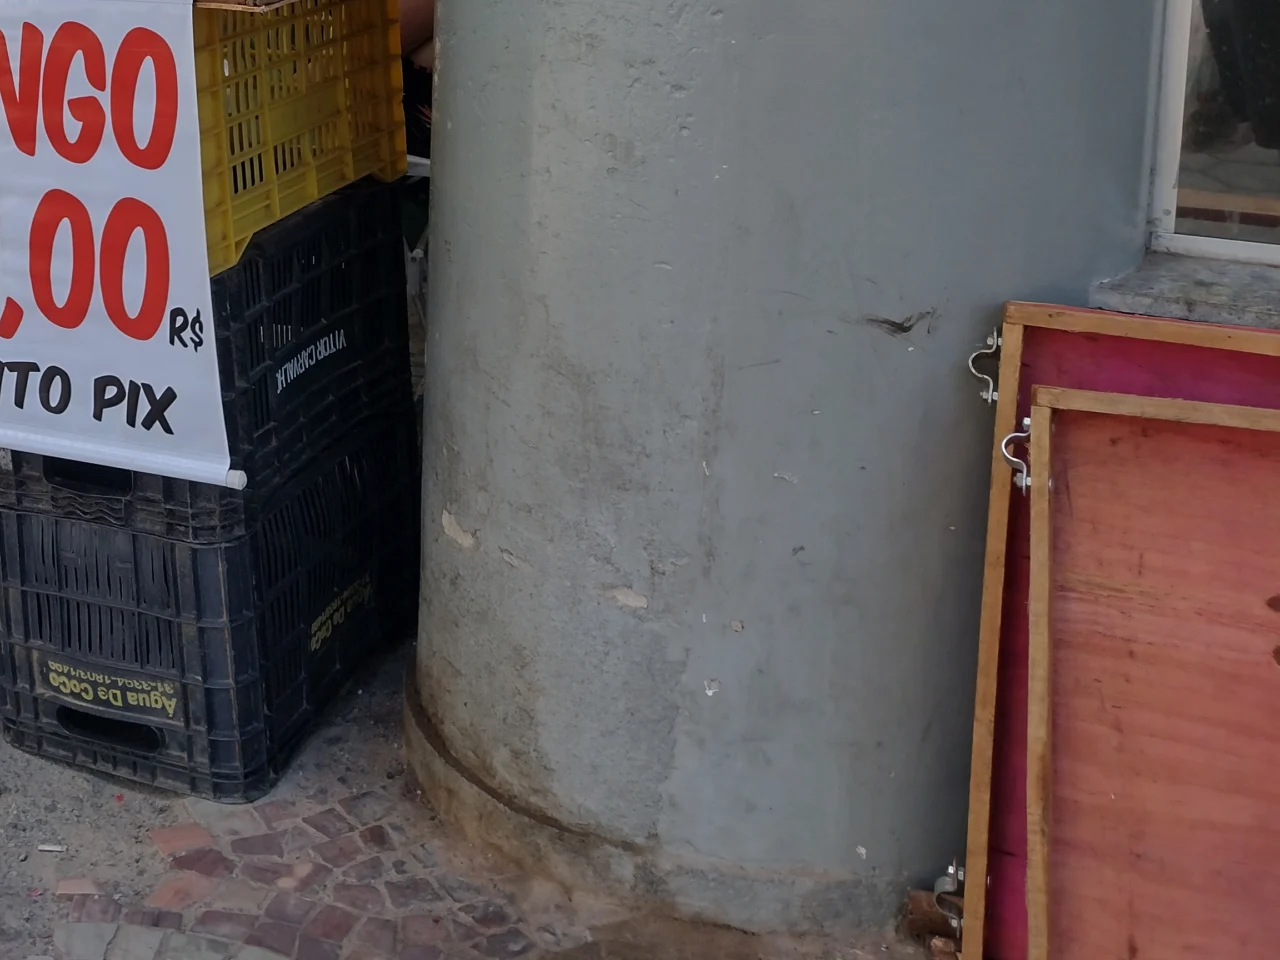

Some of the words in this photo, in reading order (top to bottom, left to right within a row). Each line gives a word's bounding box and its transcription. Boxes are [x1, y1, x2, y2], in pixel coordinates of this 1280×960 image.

[168, 307, 204, 353] R$
[316, 329, 347, 361] VITOR
[93, 375, 179, 435] PIX
[97, 688, 123, 707] De
